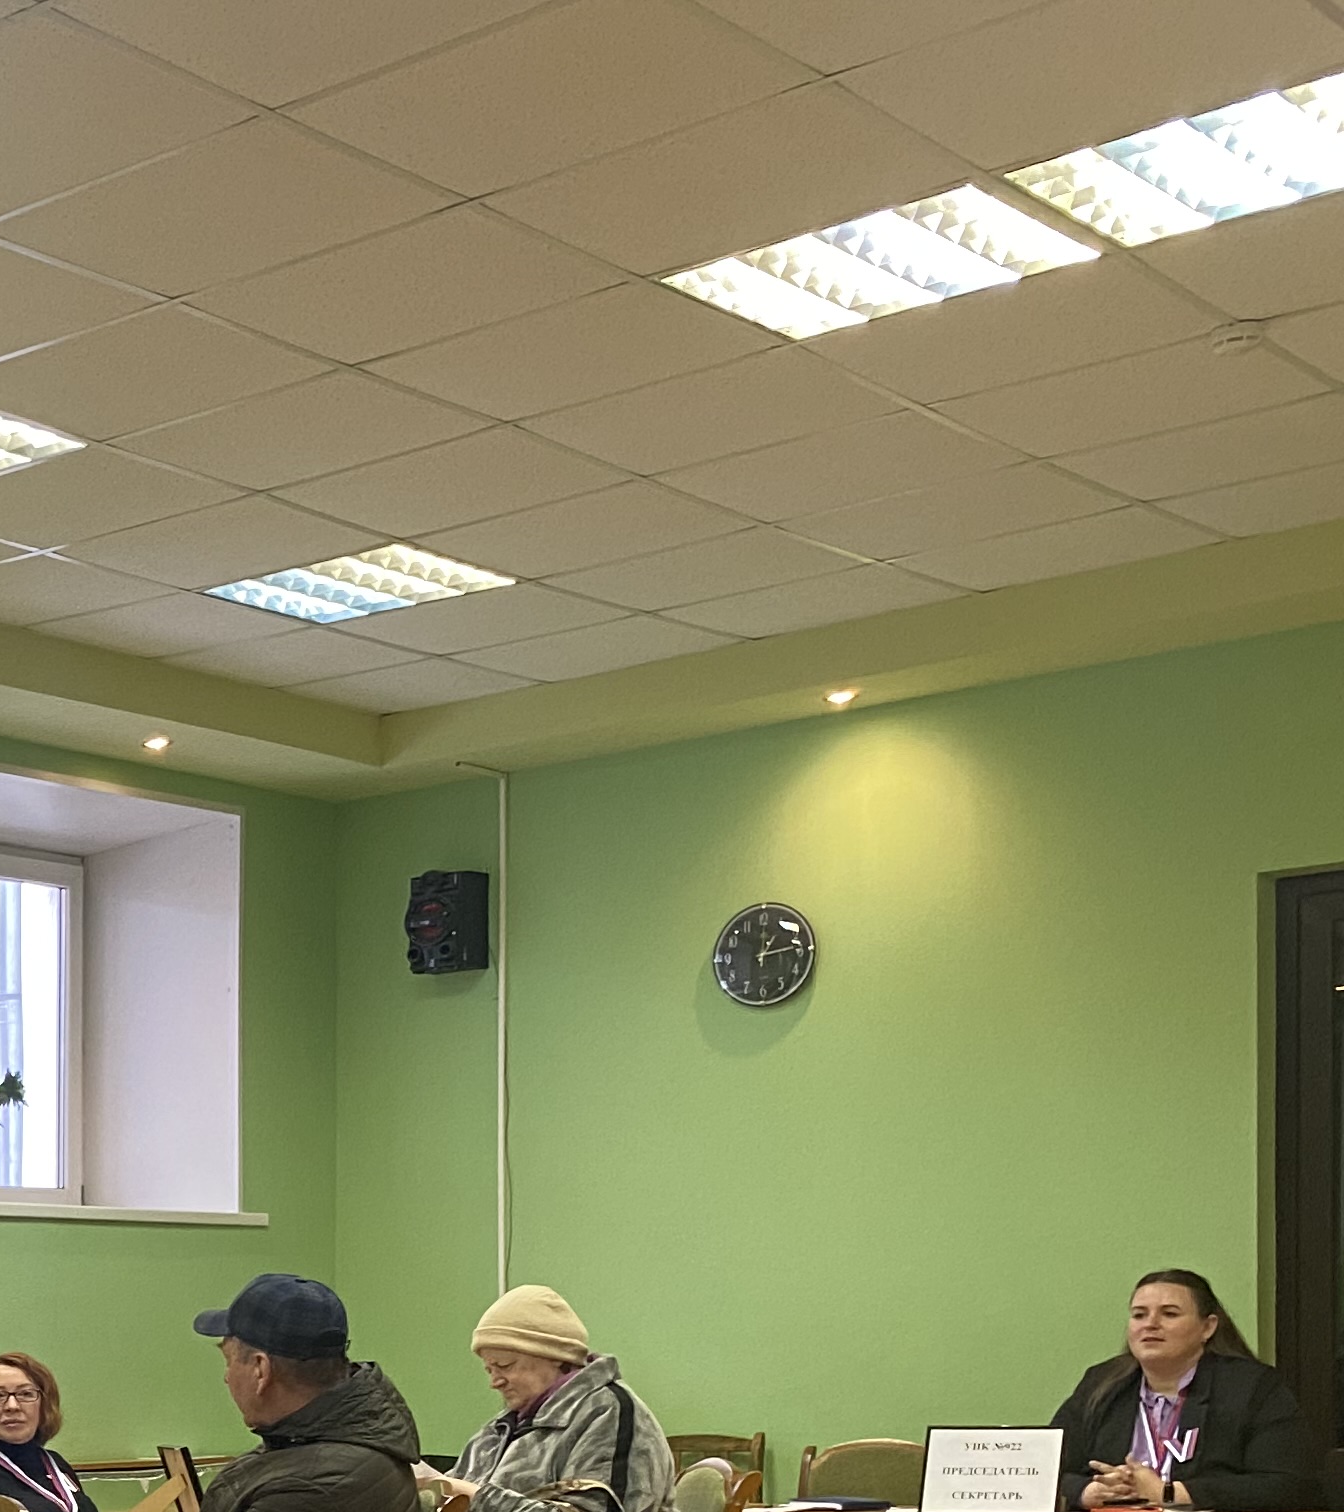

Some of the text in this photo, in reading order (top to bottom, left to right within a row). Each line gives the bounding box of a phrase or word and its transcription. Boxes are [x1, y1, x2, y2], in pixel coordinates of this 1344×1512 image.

[743, 921, 750, 933] 11
[728, 936, 738, 948] 10
[724, 953, 731, 965] 9
[792, 963, 799, 975] 4
[728, 970, 736, 982] 8
[743, 981, 750, 994] 7
[777, 977, 784, 990] 5
[759, 985, 767, 997] 6
[965, 1442, 990, 1451] УИК
[942, 1467, 1039, 1476] ПРЕДСЕДАТЕЛЬ
[952, 1491, 1023, 1500] СЕКРЕТАРЬ
